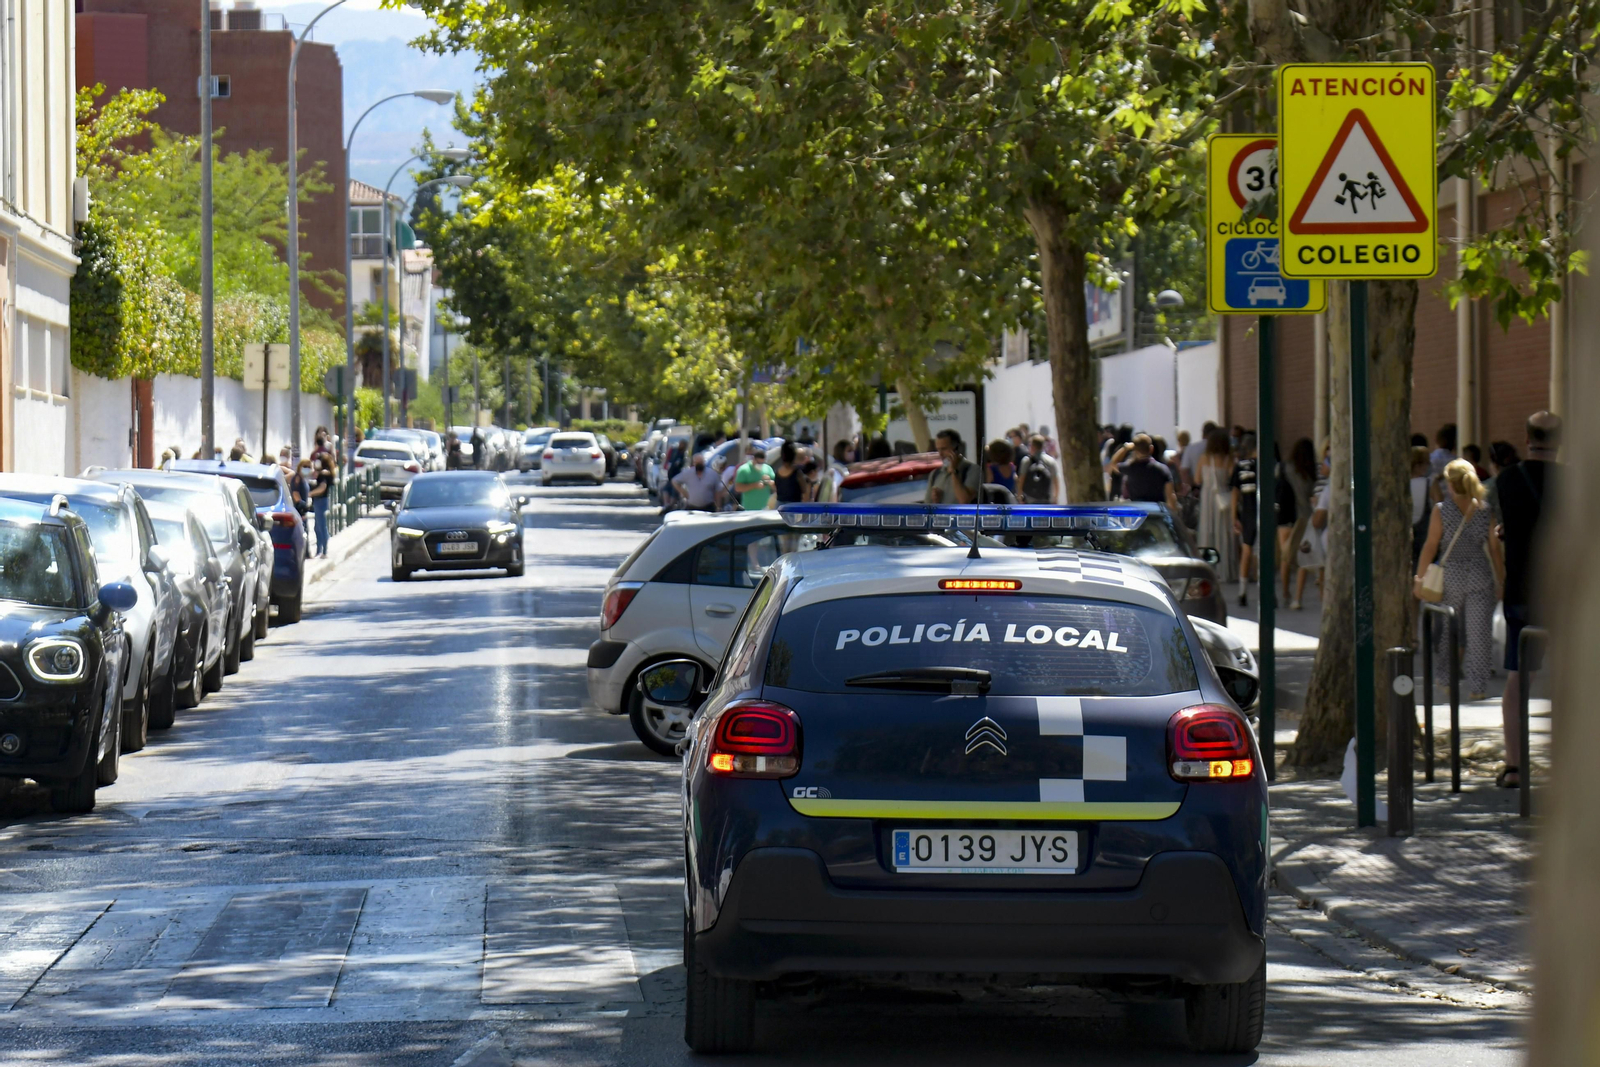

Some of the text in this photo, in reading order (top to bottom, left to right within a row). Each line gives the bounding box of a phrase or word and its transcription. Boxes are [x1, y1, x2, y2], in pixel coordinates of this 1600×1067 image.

[1290, 72, 1425, 96] ATENCIÓN
[1297, 244, 1421, 265] COLEGIO
[835, 618, 1128, 653] POLICÍA LOCAL
[899, 852, 906, 861] E
[915, 834, 1068, 863] 0139 JYS
